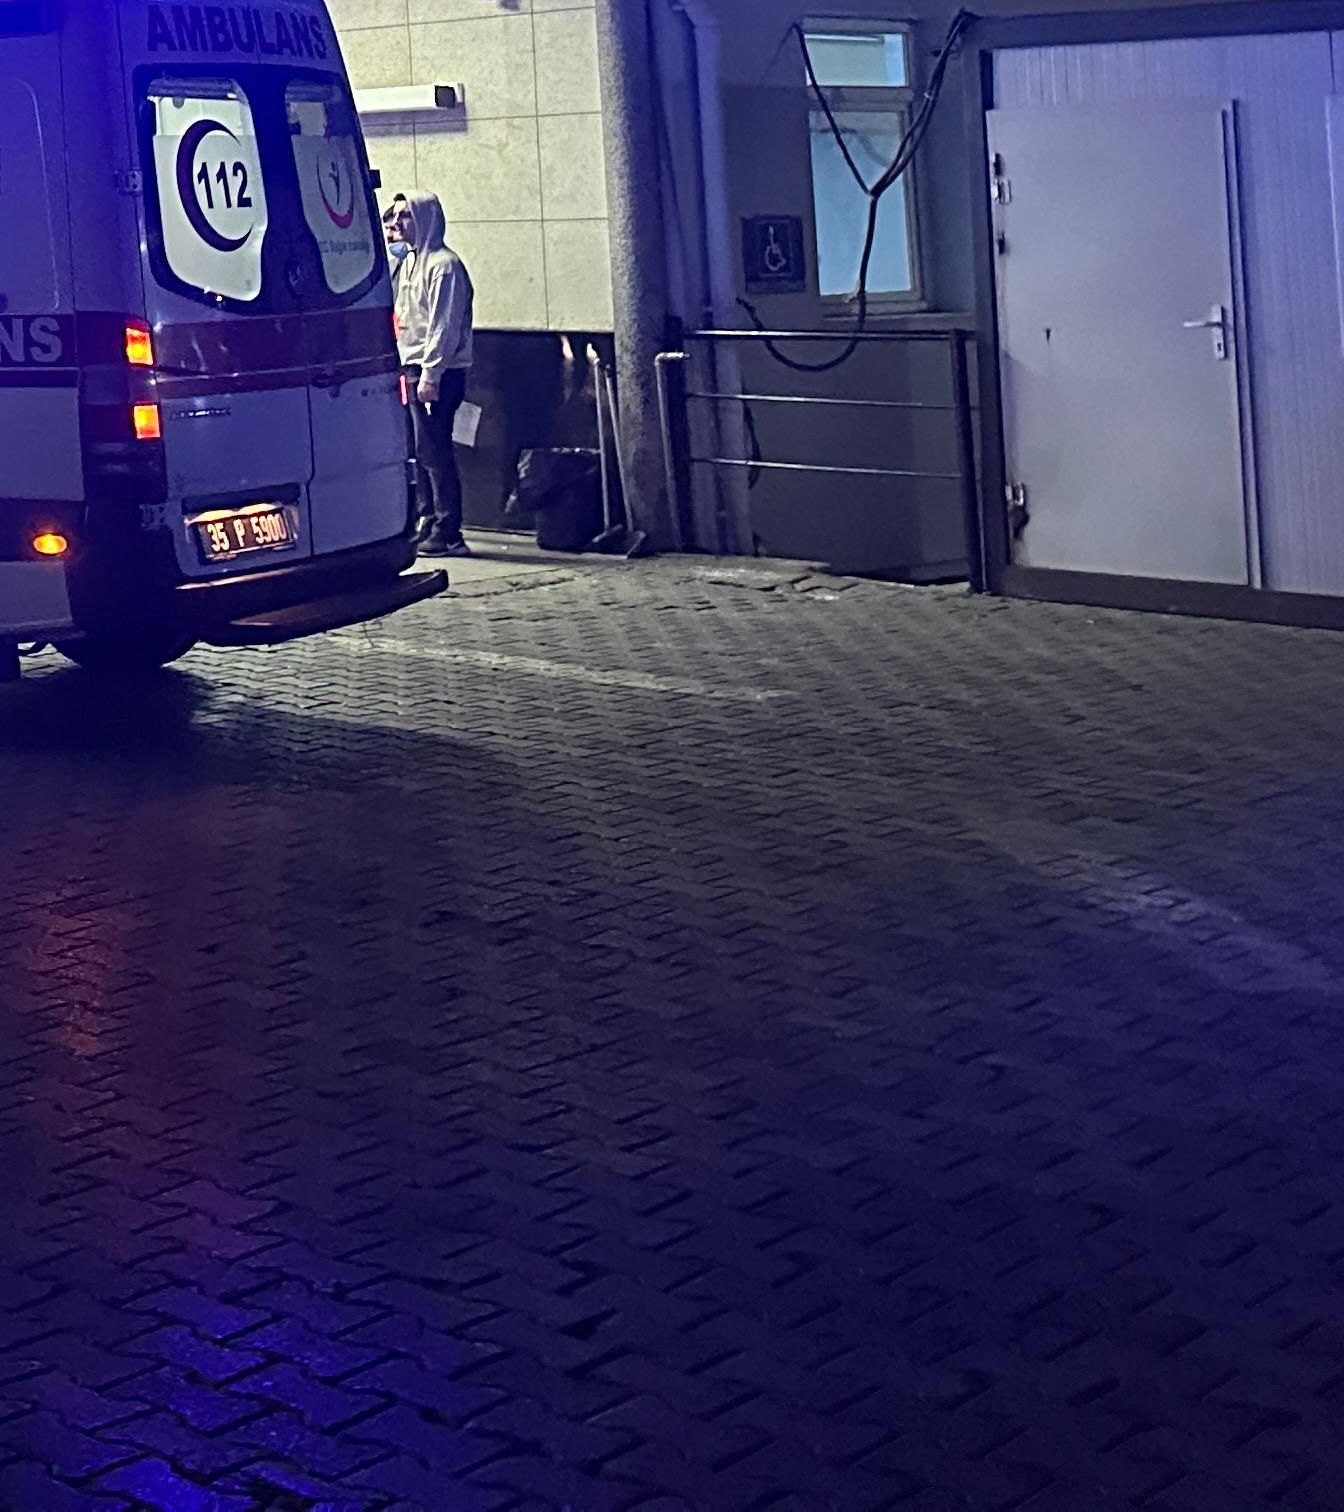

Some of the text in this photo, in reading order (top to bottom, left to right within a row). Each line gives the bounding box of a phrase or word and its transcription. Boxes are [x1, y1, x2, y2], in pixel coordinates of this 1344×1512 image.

[146, 3, 328, 60] AMBULANS
[197, 161, 253, 209] 112
[206, 521, 231, 552] 35
[233, 517, 246, 548] P
